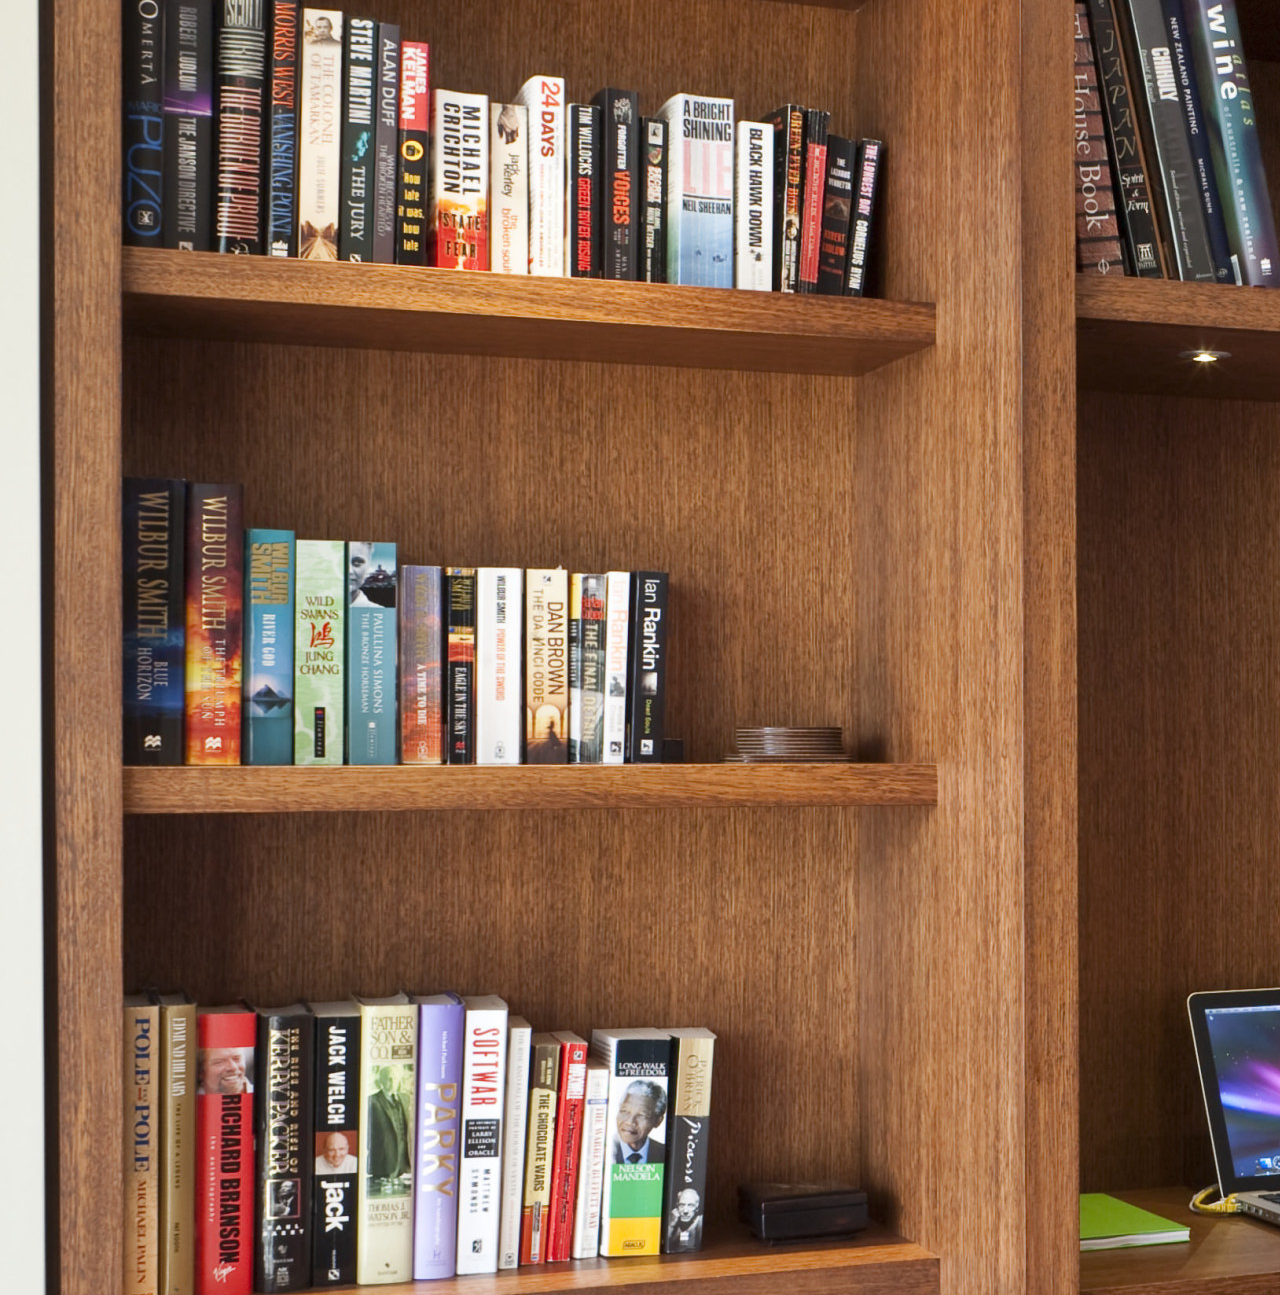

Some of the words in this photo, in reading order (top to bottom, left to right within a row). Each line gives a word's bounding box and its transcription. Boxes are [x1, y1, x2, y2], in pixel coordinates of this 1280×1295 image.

[179, 6, 198, 47] ROBERT
[273, 1, 296, 61] MORRIS
[351, 18, 374, 61] STEVE
[1170, 17, 1182, 40] NEW
[178, 51, 197, 92] LUDLUM
[219, 28, 265, 80] TUROW
[382, 38, 398, 82] ALAN
[414, 48, 428, 94] JAMES
[1174, 41, 1190, 86] ZEALAND
[1206, 3, 1238, 100] wine
[272, 66, 295, 109] WEST
[348, 65, 373, 125] MARTINI
[401, 46, 416, 120] KELMAN
[541, 81, 561, 108] 24
[1102, 29, 1137, 159] JAPAN
[1231, 54, 1254, 126] atlas
[178, 117, 197, 133] THE
[381, 86, 397, 127] DUFF
[578, 107, 593, 124] TIM
[683, 99, 691, 117] A
[692, 100, 731, 122] BRIGHT
[1181, 87, 1199, 135] PAINTING
[271, 113, 295, 188] VANISHING
[442, 101, 461, 195] CRICHTON
[461, 105, 481, 196] MICHAEL
[540, 111, 555, 158] DAYS
[578, 125, 593, 176] WILLOCKS
[683, 118, 732, 142] SHINING
[749, 127, 763, 167] BLACK
[127, 114, 163, 237] PUZO
[178, 134, 197, 178] JANSON
[682, 140, 732, 196] LIE
[350, 166, 366, 198] THE
[613, 171, 631, 225] VOICES
[749, 169, 763, 208] HAWK
[1079, 164, 1109, 231] Book
[1197, 158, 1208, 190] MICHAEL
[1204, 191, 1213, 214] DUNN
[177, 179, 197, 233] DIRECTIVE
[271, 191, 293, 236] POINT
[349, 200, 365, 241] JURY
[442, 212, 482, 231] STATE
[682, 199, 697, 212] NEIL
[698, 201, 732, 215] SHEEHAN
[749, 208, 763, 248] DOWN
[445, 239, 477, 259] FEAR
[852, 220, 869, 266] CORNELIUS
[848, 267, 863, 290] RYAN
[138, 490, 169, 572] WILBUR
[202, 496, 228, 572] WILBUR
[251, 542, 272, 605] SMITH
[271, 541, 289, 605] WILBUR
[644, 578, 660, 603] Ian
[137, 576, 169, 640] SMITH
[201, 574, 227, 631] SMITH
[300, 608, 340, 621] SWANS
[305, 595, 334, 607] WILD
[362, 613, 370, 628] THE
[533, 589, 544, 614] THE
[533, 615, 543, 631] DA
[547, 601, 564, 635] DAN
[262, 613, 276, 644] RIVER
[362, 631, 370, 663] BRONZE
[372, 613, 384, 663] PAULLINA
[642, 607, 661, 670] Rankin
[261, 646, 276, 667] GOD
[299, 663, 340, 676] CHANG
[305, 650, 334, 663] JUNG
[533, 638, 544, 664] VINCI
[547, 636, 564, 696] BROWN
[137, 647, 153, 701] HORIZON
[152, 661, 168, 687] BLUE
[361, 665, 370, 714] HORSEMAN
[372, 665, 384, 714] SIMONS
[455, 667, 467, 692] EAGLE
[532, 666, 544, 704] CODE
[454, 702, 467, 719] THE
[455, 693, 466, 702] IN
[454, 719, 467, 735] SKY
[370, 1016, 414, 1031] FATHER
[370, 1031, 396, 1045] SON
[399, 1030, 412, 1044] &
[134, 1018, 150, 1086] POLE
[269, 1027, 291, 1094] KERRY
[327, 1025, 347, 1067] JACK
[470, 1027, 501, 1106] SOFTWAR
[618, 1062, 643, 1070] LONG
[642, 1062, 666, 1070] WALK
[326, 1070, 346, 1125] WELCH
[537, 1093, 550, 1111] THE
[134, 1105, 150, 1173] POLE
[220, 1094, 242, 1174] RICHARD
[269, 1099, 290, 1176] PACKER
[422, 1082, 458, 1198] PARKY
[534, 1114, 549, 1163] CHOCOLATE
[533, 1165, 547, 1192] WARS
[612, 1172, 661, 1182] MANDELA
[618, 1163, 656, 1173] NELSON
[219, 1178, 241, 1264] BRANSON
[321, 1181, 350, 1233] jack
